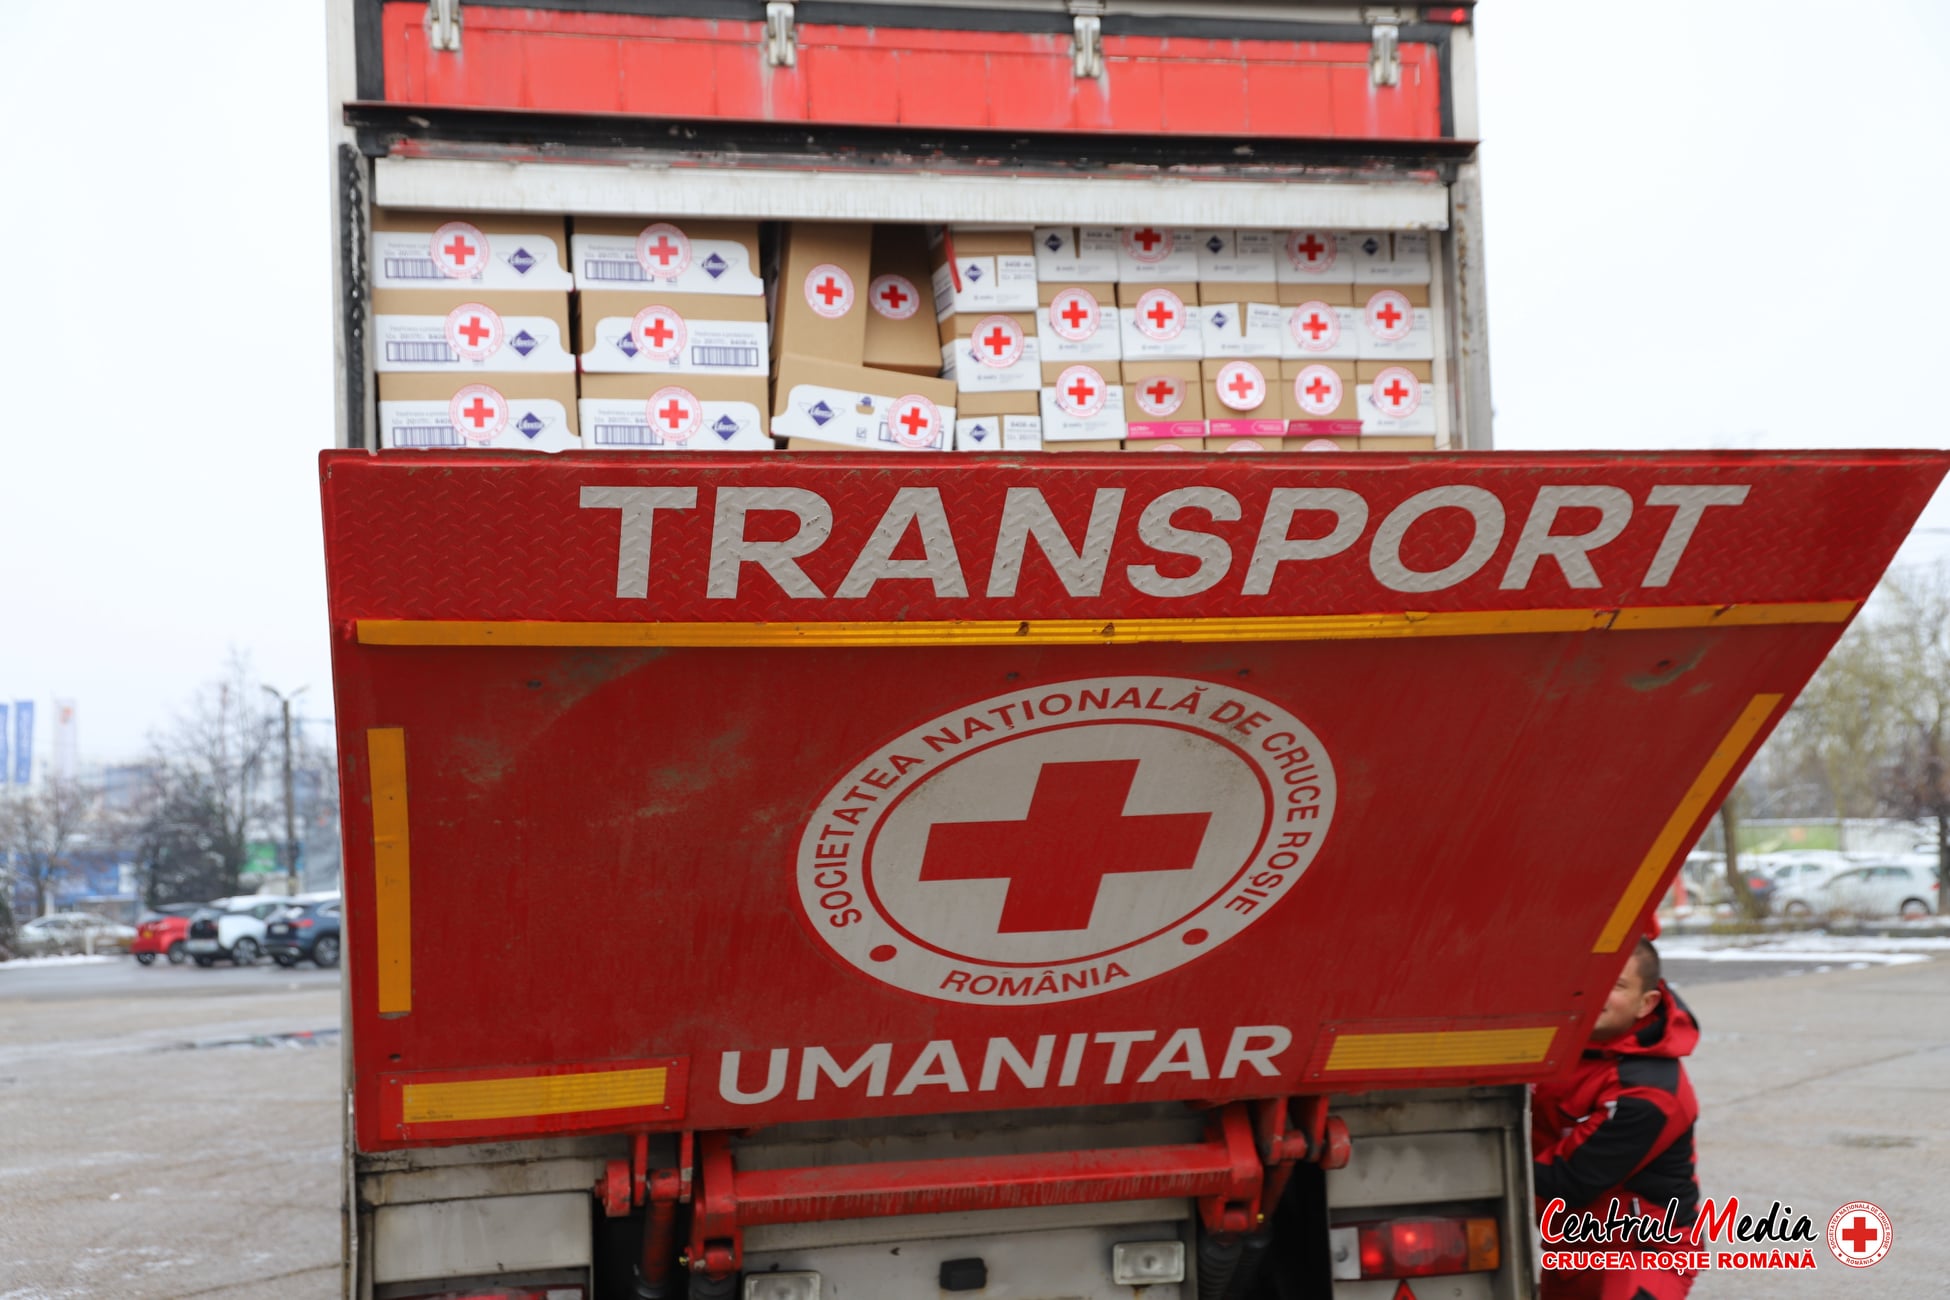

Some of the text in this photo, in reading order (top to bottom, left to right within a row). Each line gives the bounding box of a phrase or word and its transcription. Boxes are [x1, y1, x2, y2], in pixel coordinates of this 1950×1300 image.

[580, 484, 1752, 599] TRANSPORT
[1208, 699, 1272, 735] DE
[1261, 730, 1321, 822] CRUCE
[814, 753, 925, 929] SOCIETATEA
[1223, 831, 1312, 915] ROȘIE
[939, 961, 1132, 997] ROMÂNIA
[718, 1025, 1293, 1105] UMANITAR
